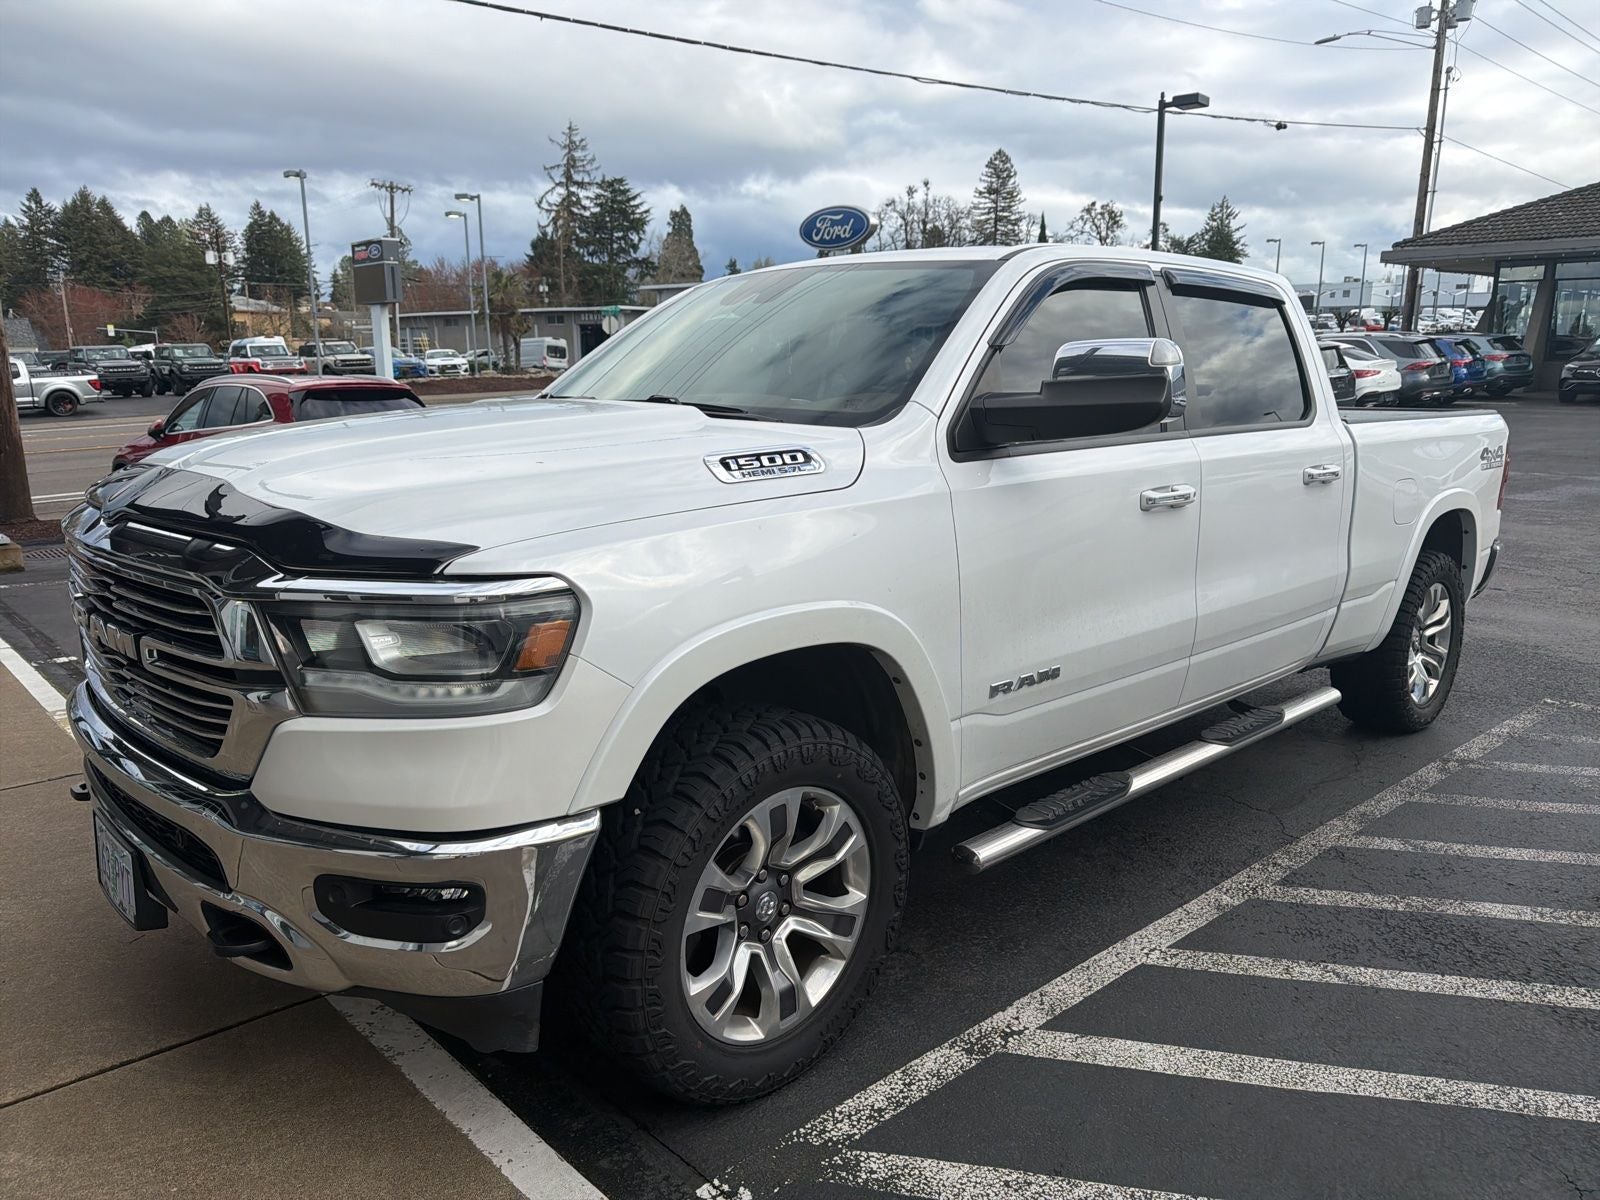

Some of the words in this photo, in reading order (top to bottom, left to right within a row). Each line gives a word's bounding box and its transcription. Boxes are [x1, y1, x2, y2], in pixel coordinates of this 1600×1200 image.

[812, 213, 854, 242] Ford
[725, 452, 805, 471] 1500
[1480, 445, 1504, 463] 4x4
[741, 468, 777, 478] HEMI
[779, 464, 807, 474] 5.7L
[72, 600, 137, 661] RAM
[989, 665, 1060, 699] RAM
